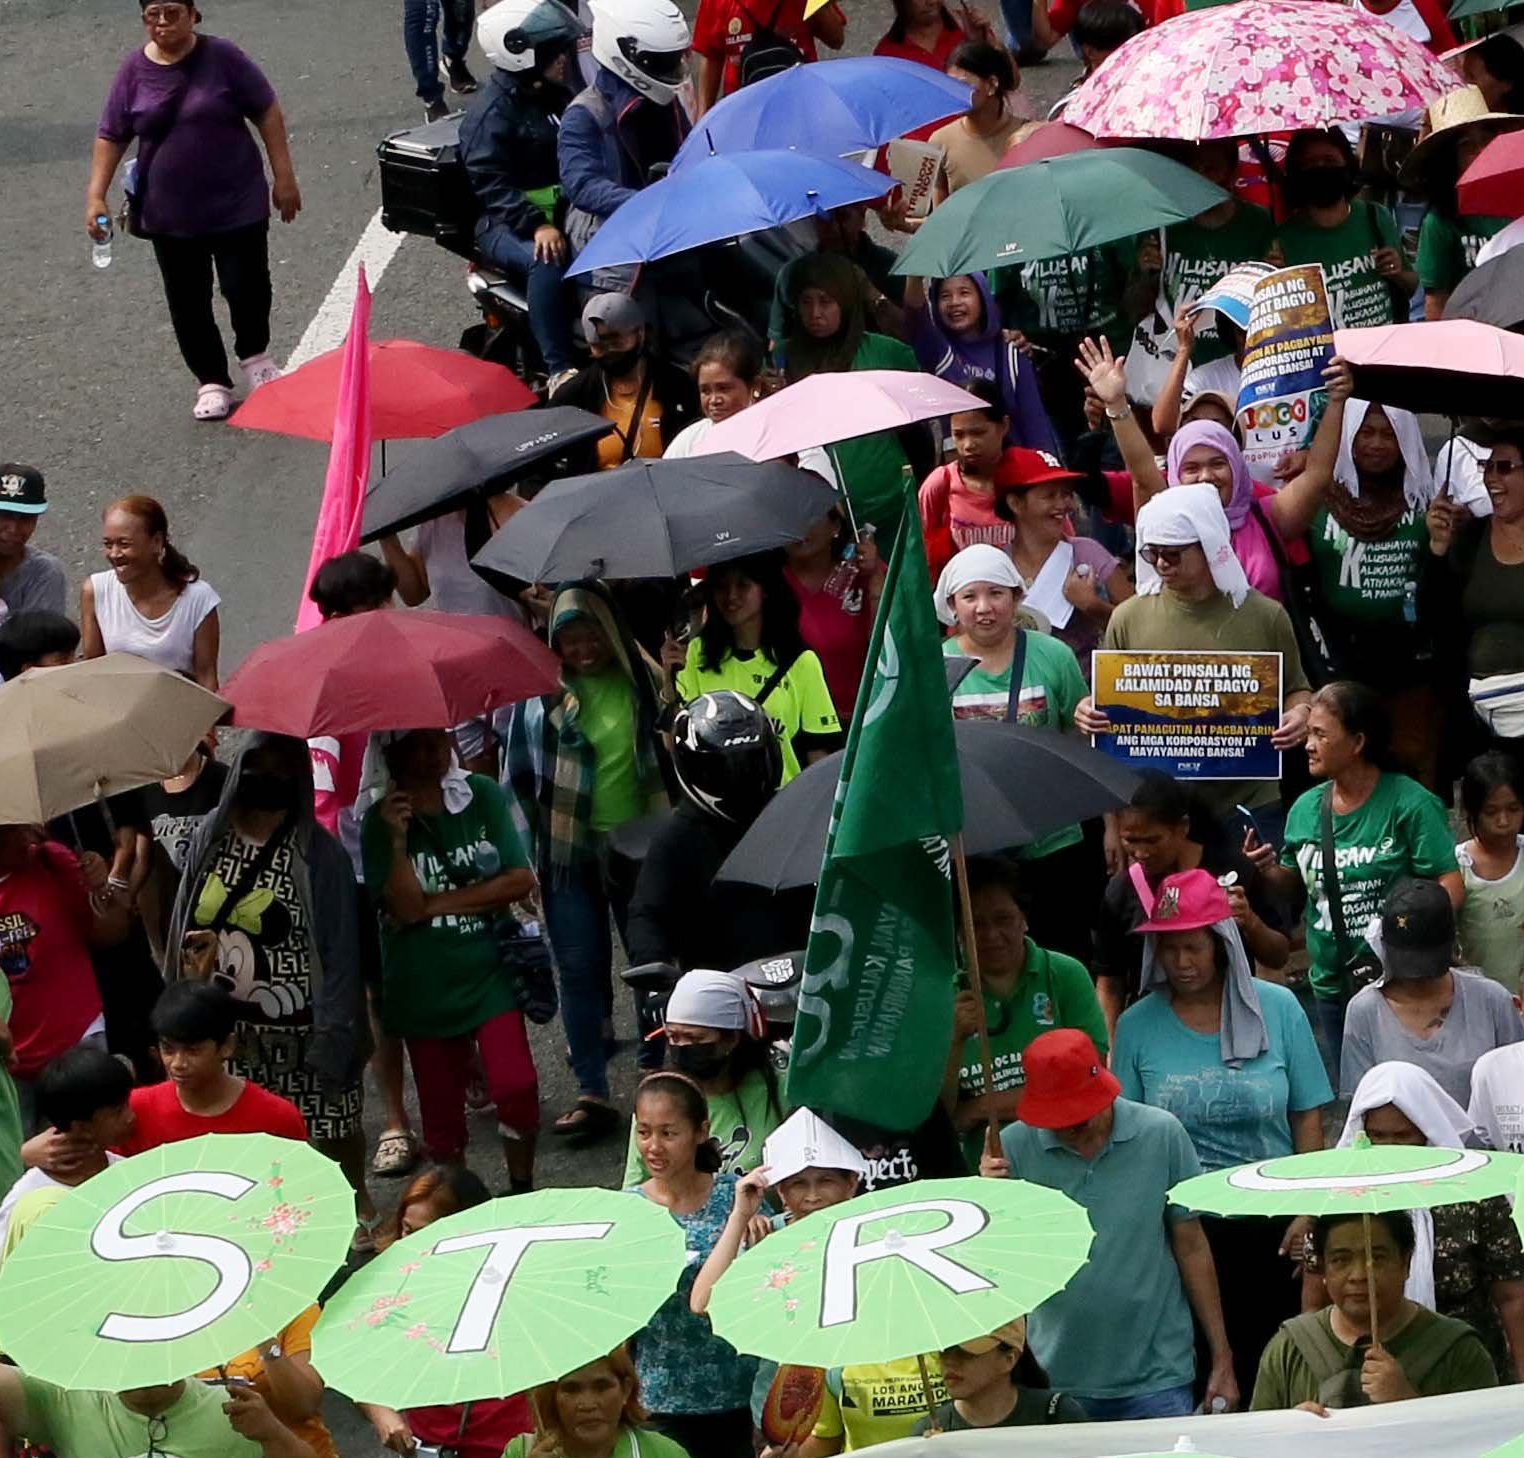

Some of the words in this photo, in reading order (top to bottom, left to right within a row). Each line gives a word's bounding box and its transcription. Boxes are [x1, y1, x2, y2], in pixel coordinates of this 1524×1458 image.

[1287, 278, 1306, 292] NG
[1274, 291, 1316, 309] BAGYO
[1123, 664, 1171, 678] BAWAT
[1173, 664, 1229, 678] PINSALA
[1231, 664, 1251, 678] NG
[1115, 679, 1192, 692] KALAMIDAD
[1194, 679, 1211, 692] AT
[1214, 679, 1260, 693] BAGYO
[1154, 693, 1172, 707] SA
[1175, 693, 1220, 707] BANSA
[1108, 724, 1133, 734] APAT
[1134, 724, 1193, 735] PANAGUTIN
[1194, 725, 1208, 735] AT
[1209, 725, 1276, 736] PAGBAYARIN
[1117, 735, 1138, 746] ANG
[1140, 735, 1164, 746] MGA
[1165, 735, 1242, 747] KORPORASYON
[1244, 736, 1258, 746] AT
[1129, 747, 1205, 758] MAYAYAMANG
[1206, 747, 1245, 758] BANSA!
